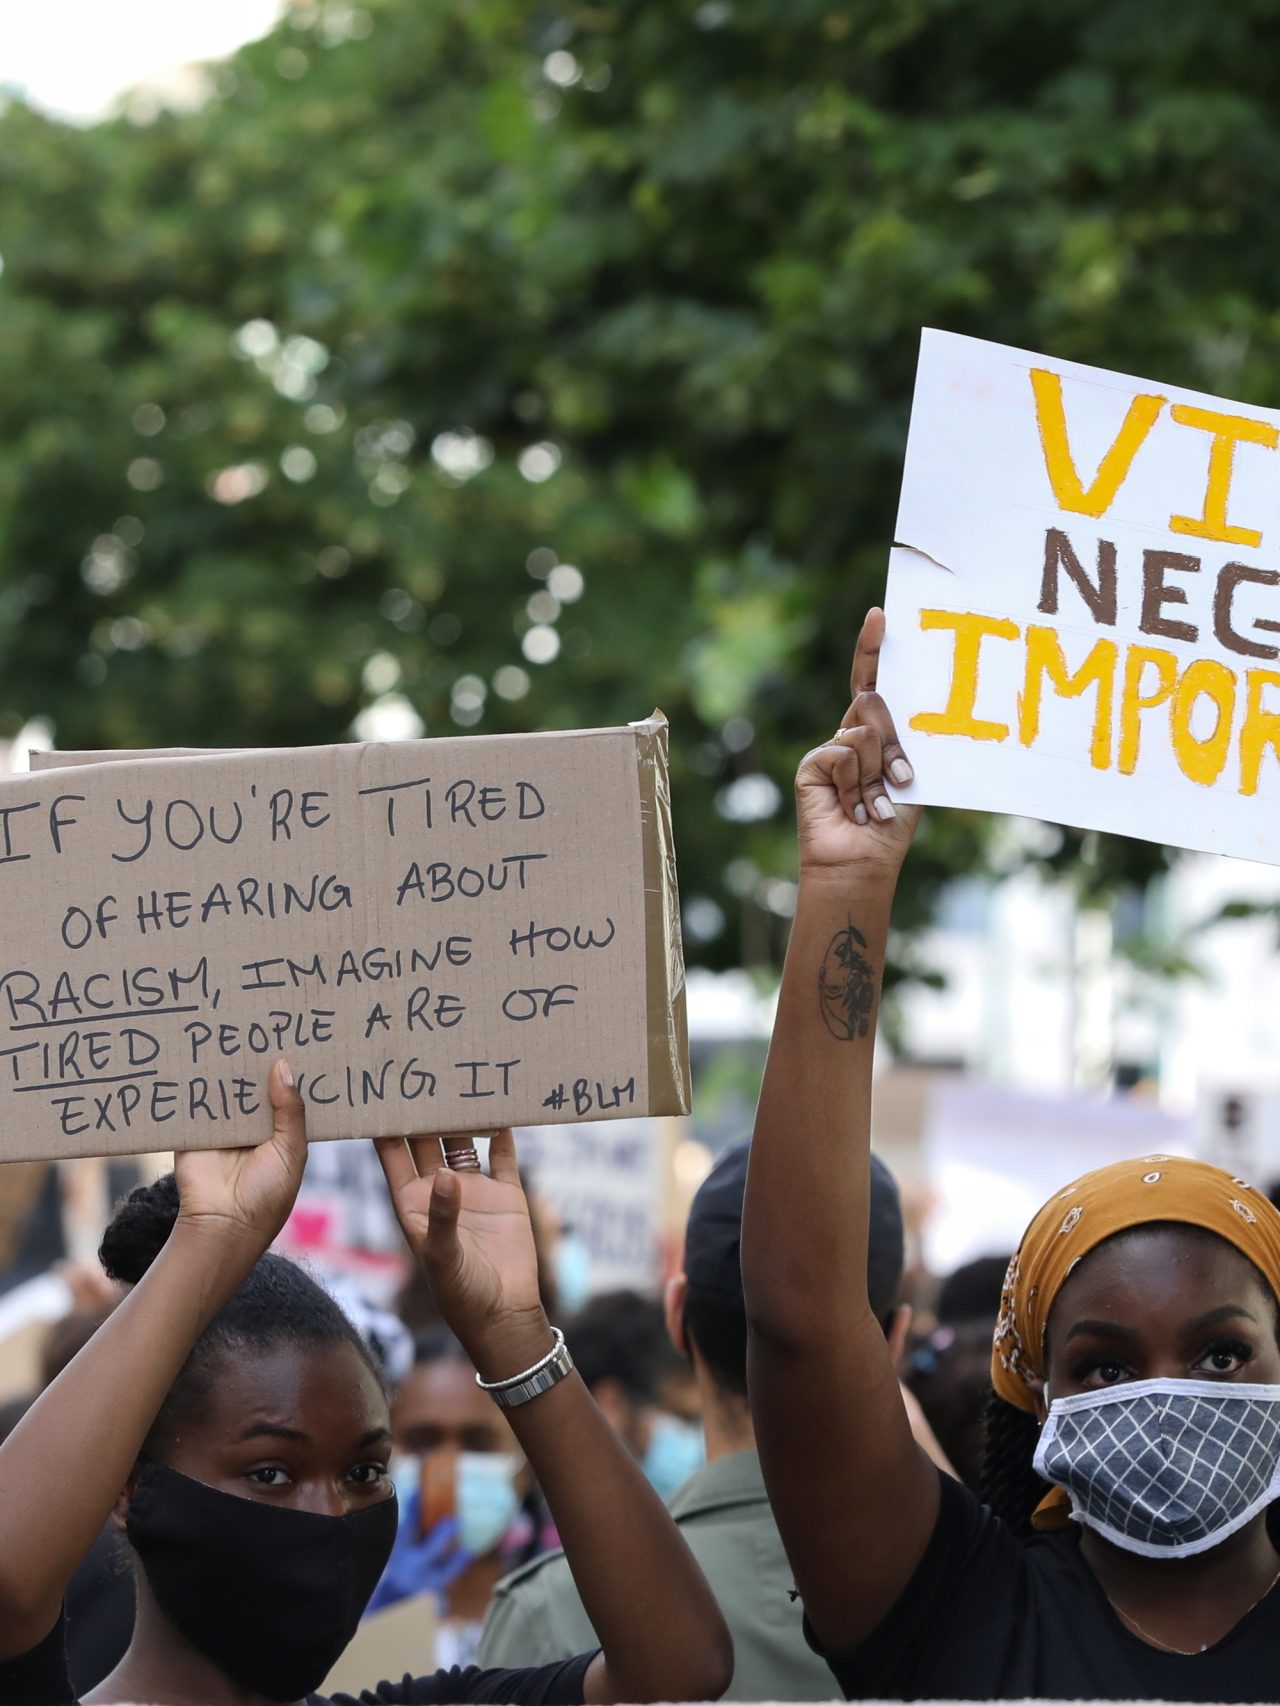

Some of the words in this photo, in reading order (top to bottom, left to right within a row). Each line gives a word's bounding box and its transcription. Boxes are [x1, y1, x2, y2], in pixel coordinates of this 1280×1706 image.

[0, 795, 84, 863] IF
[112, 785, 330, 862] YOU'RE
[359, 778, 544, 836] TIRED
[62, 896, 117, 949] OF
[137, 875, 352, 933] HEARING
[397, 854, 547, 905] ABOUT
[0, 957, 220, 1021] RACISM,
[242, 937, 471, 989] IMAGINE
[510, 918, 615, 953] HOW
[0, 1030, 160, 1080] TIRED
[184, 1009, 335, 1063] PEOPLE
[365, 987, 465, 1038] ARE
[502, 985, 578, 1021] OF
[52, 1057, 436, 1135] EXPERIECING
[455, 1060, 520, 1098] IT
[542, 1077, 634, 1116] #BLM
